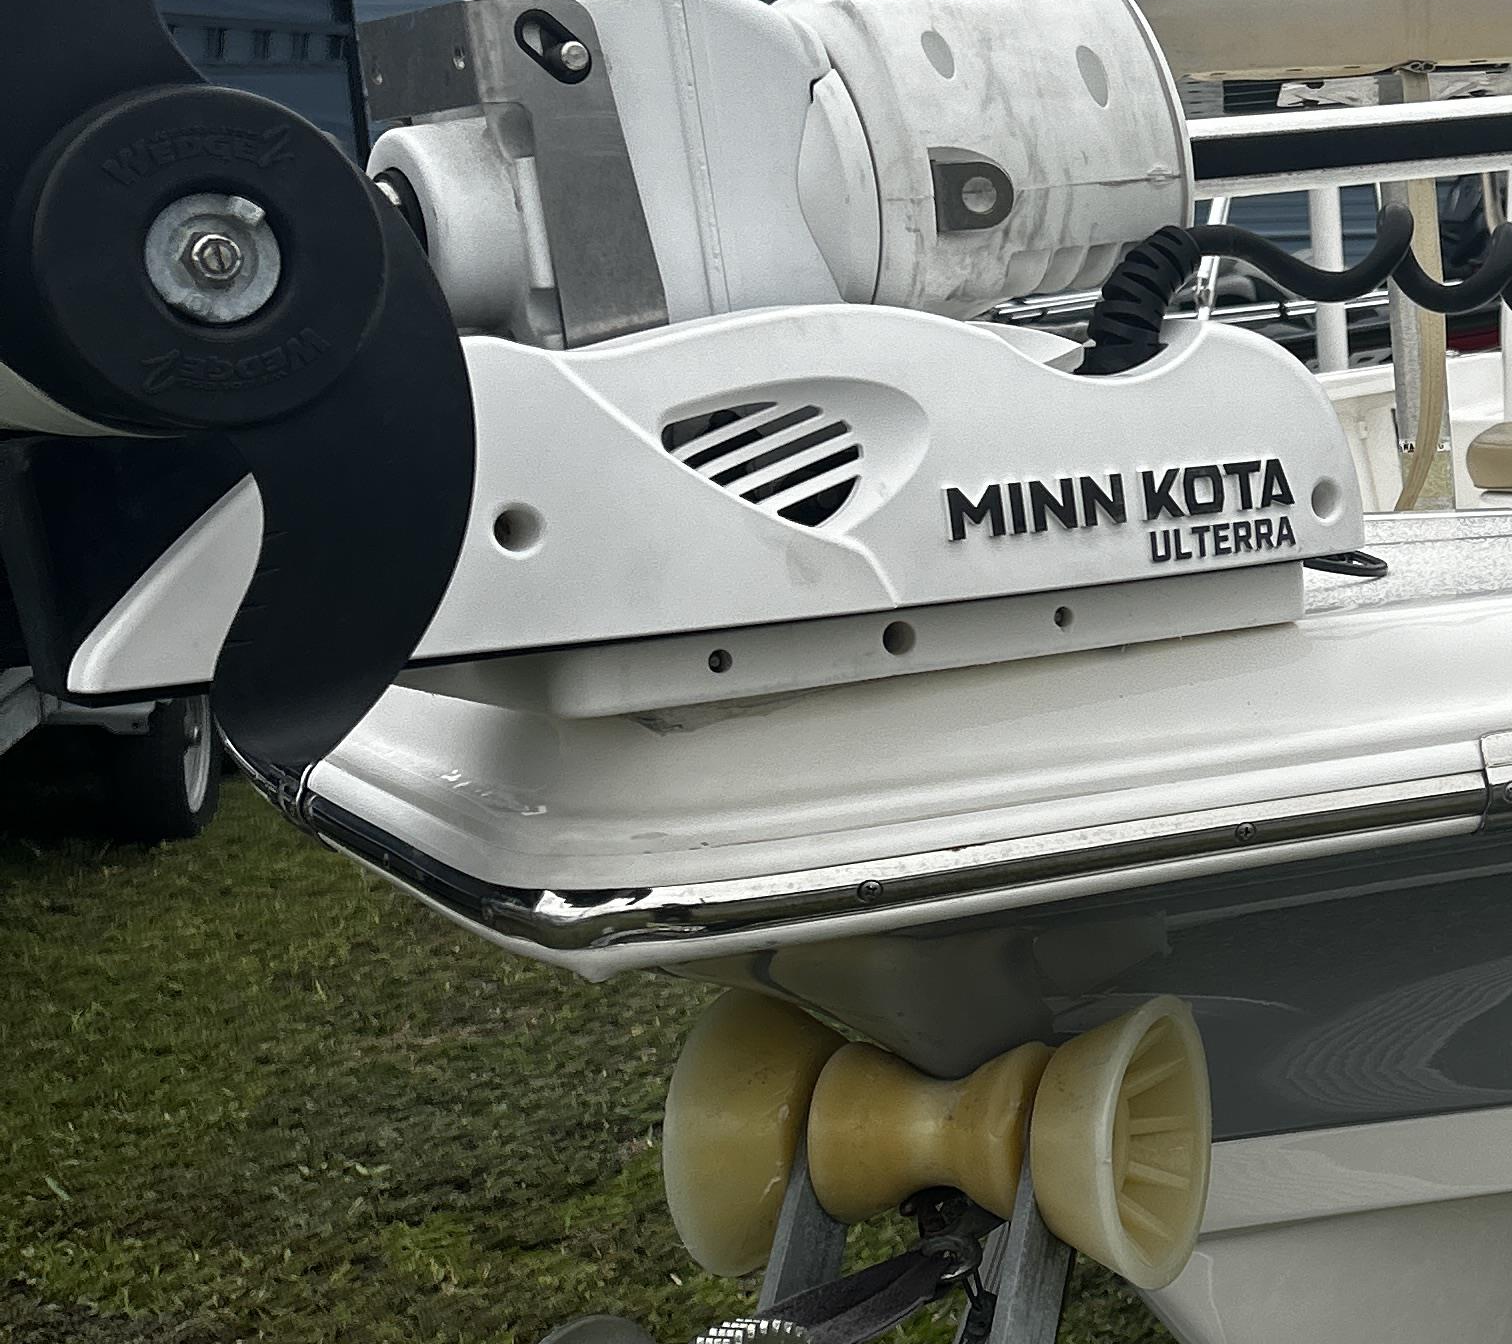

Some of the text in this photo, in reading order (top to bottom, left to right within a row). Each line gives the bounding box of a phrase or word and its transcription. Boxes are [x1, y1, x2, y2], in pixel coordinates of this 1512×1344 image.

[943, 457, 1296, 542] MINN KOTA
[1149, 516, 1297, 563] ULTERRA
